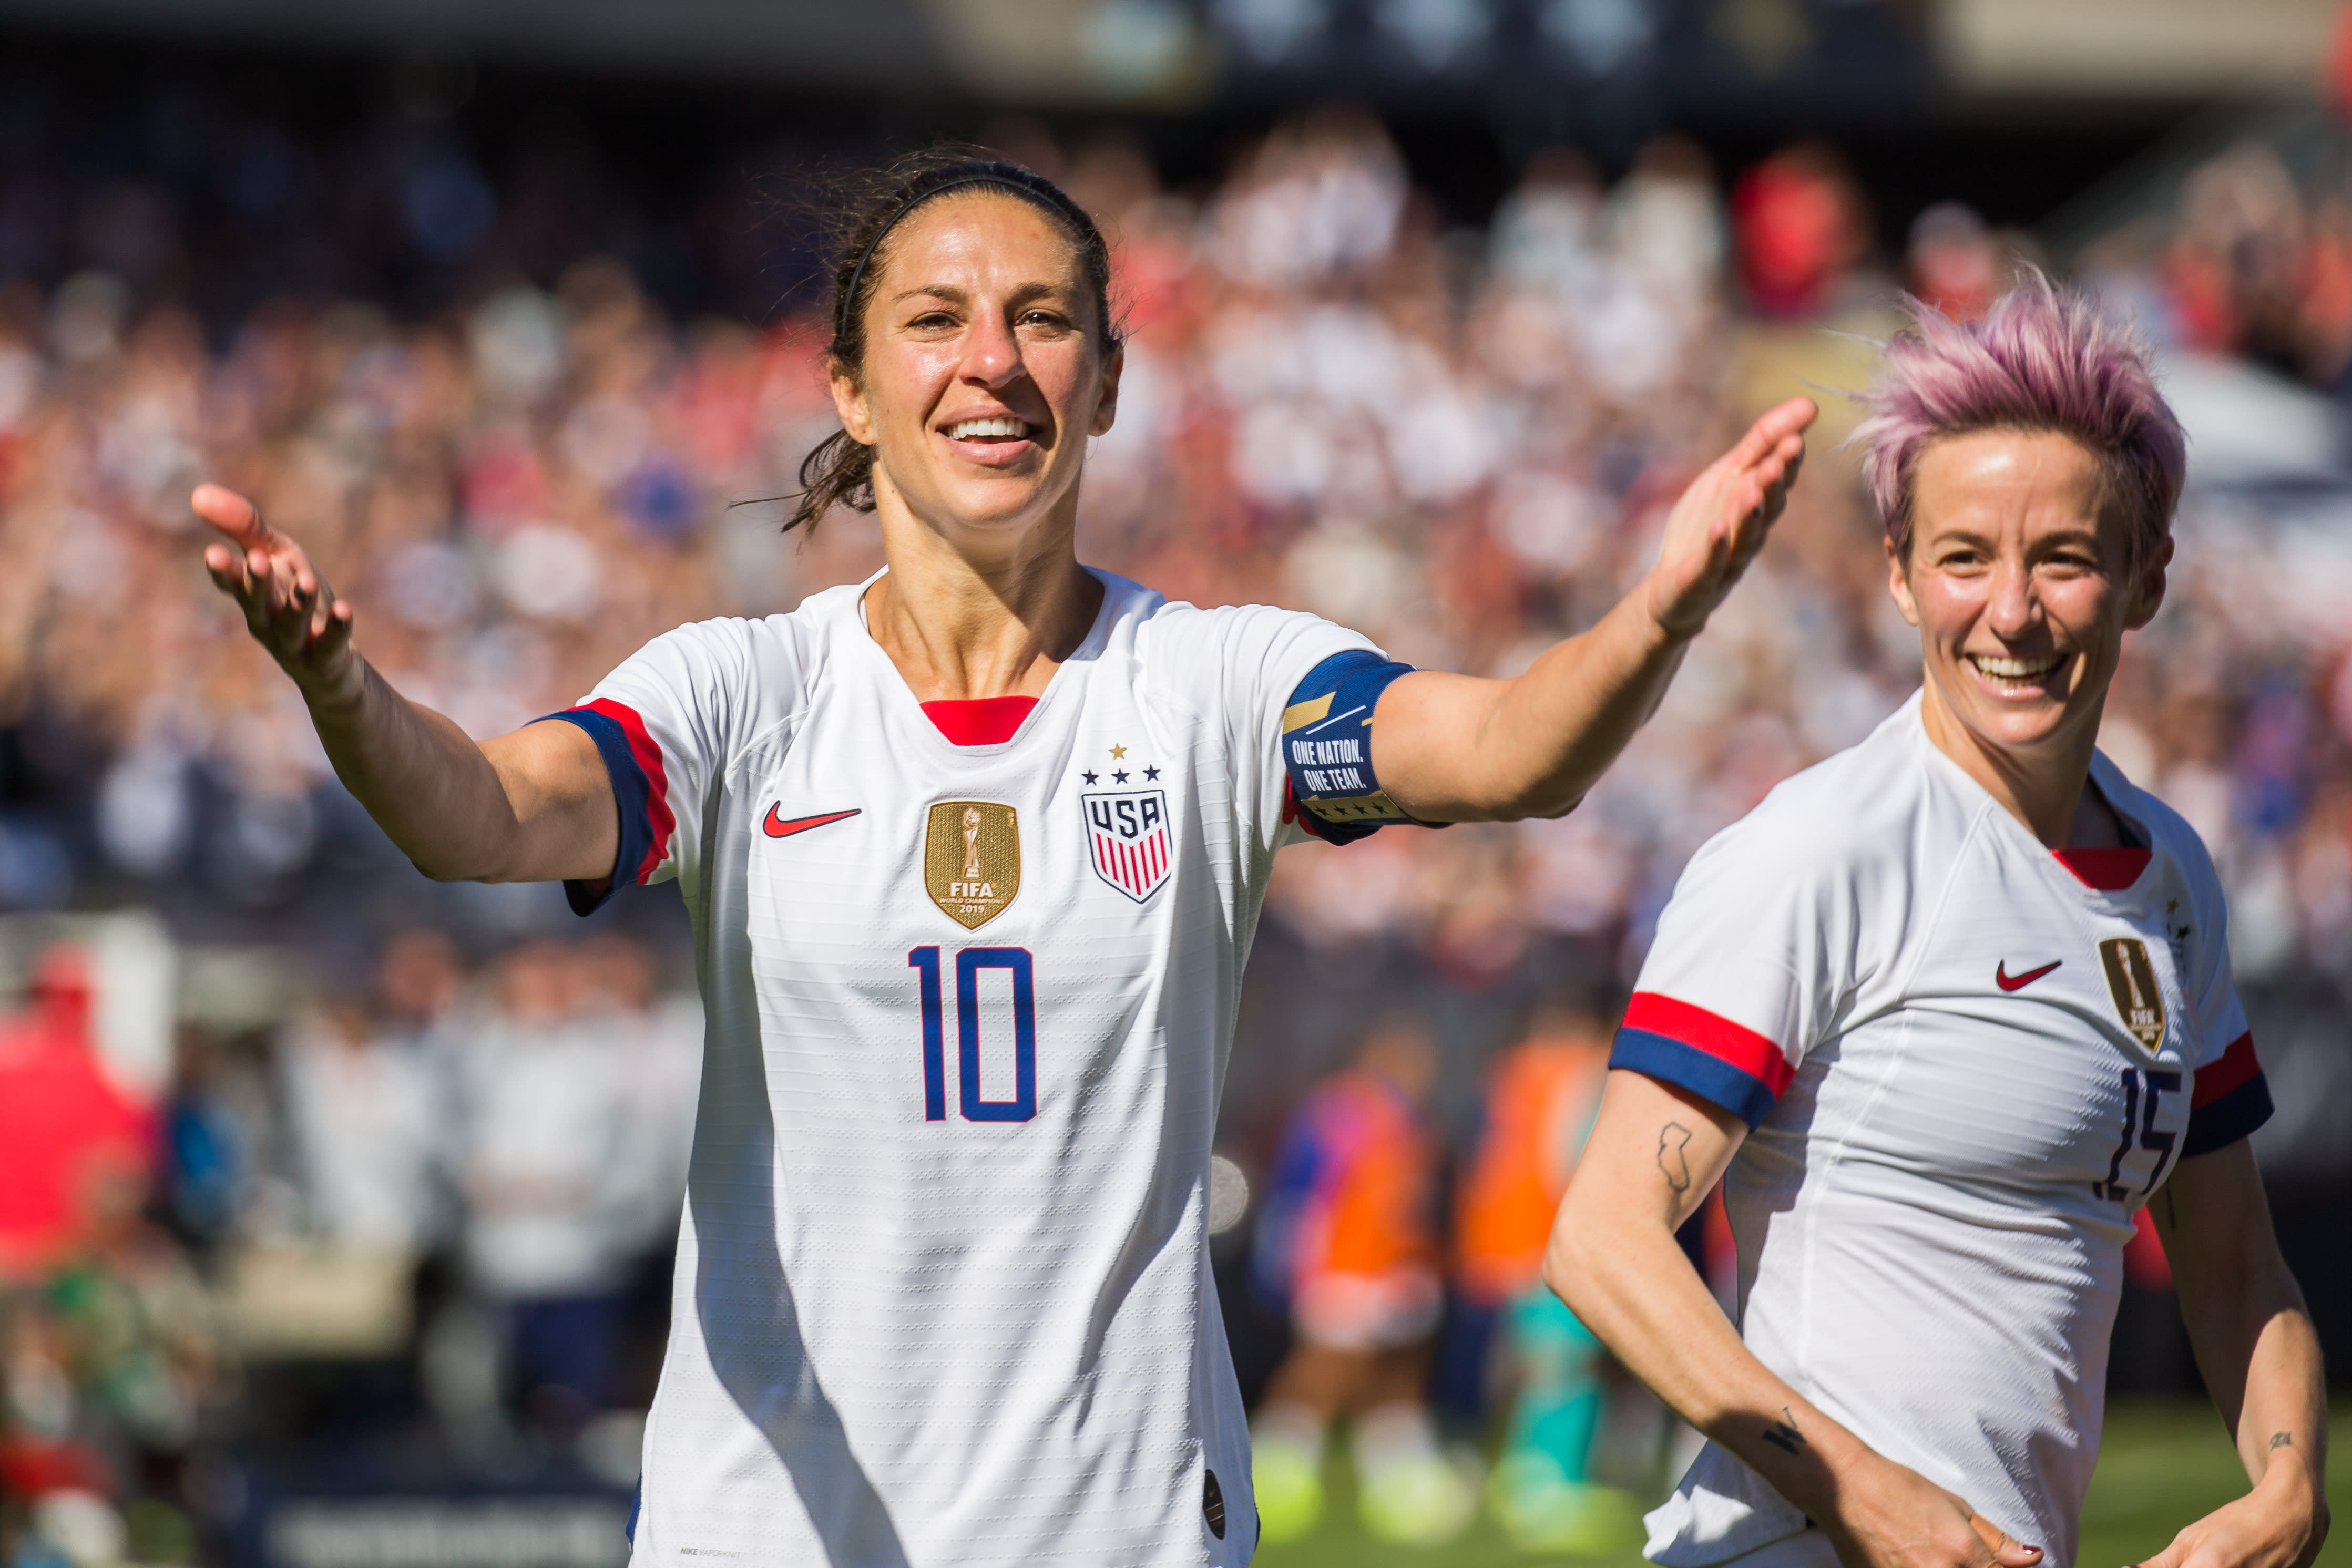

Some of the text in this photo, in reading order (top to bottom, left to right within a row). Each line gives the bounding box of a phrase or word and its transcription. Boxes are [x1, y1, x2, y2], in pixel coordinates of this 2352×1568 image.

[1292, 739, 1364, 765] ONE NATION.
[1304, 768, 1367, 791] ONE TEAM.
[1091, 797, 1160, 839] USA
[950, 882, 994, 897] FIFA
[959, 905, 985, 913] 2019
[908, 945, 1037, 1122] 10
[2092, 1067, 2182, 1202] 15
